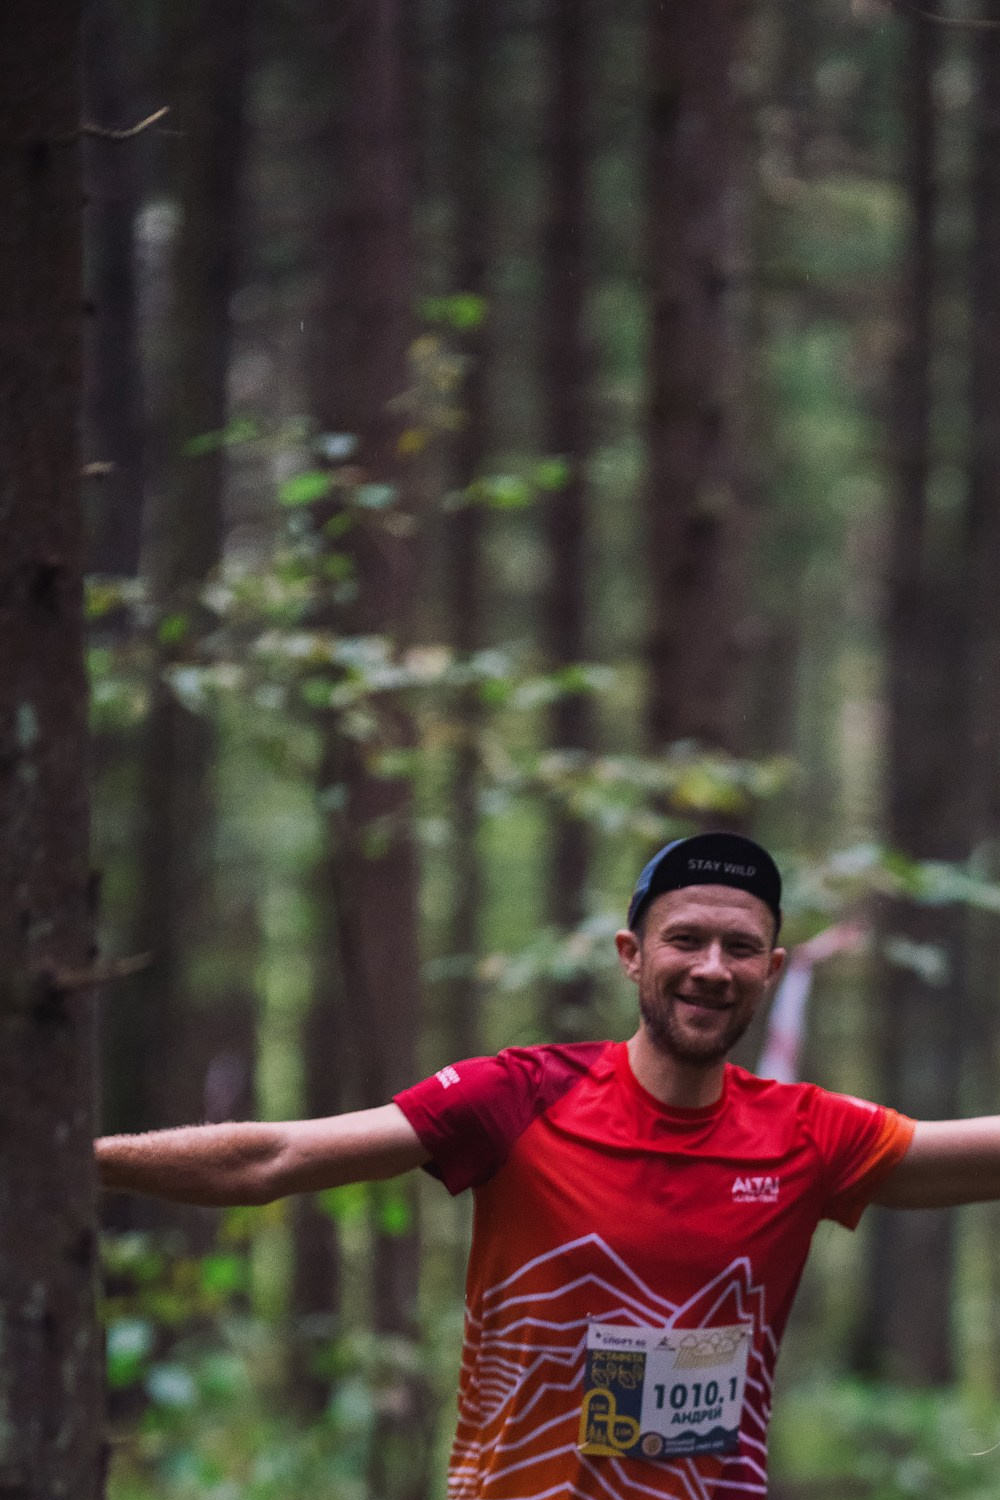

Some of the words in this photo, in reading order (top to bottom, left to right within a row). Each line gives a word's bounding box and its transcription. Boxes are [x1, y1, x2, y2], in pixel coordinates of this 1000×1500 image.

[688, 859, 721, 871] STAY
[724, 862, 757, 877] WILD
[654, 1376, 738, 1410] 1010.1
[671, 1405, 723, 1425] АНДРЕЙ
